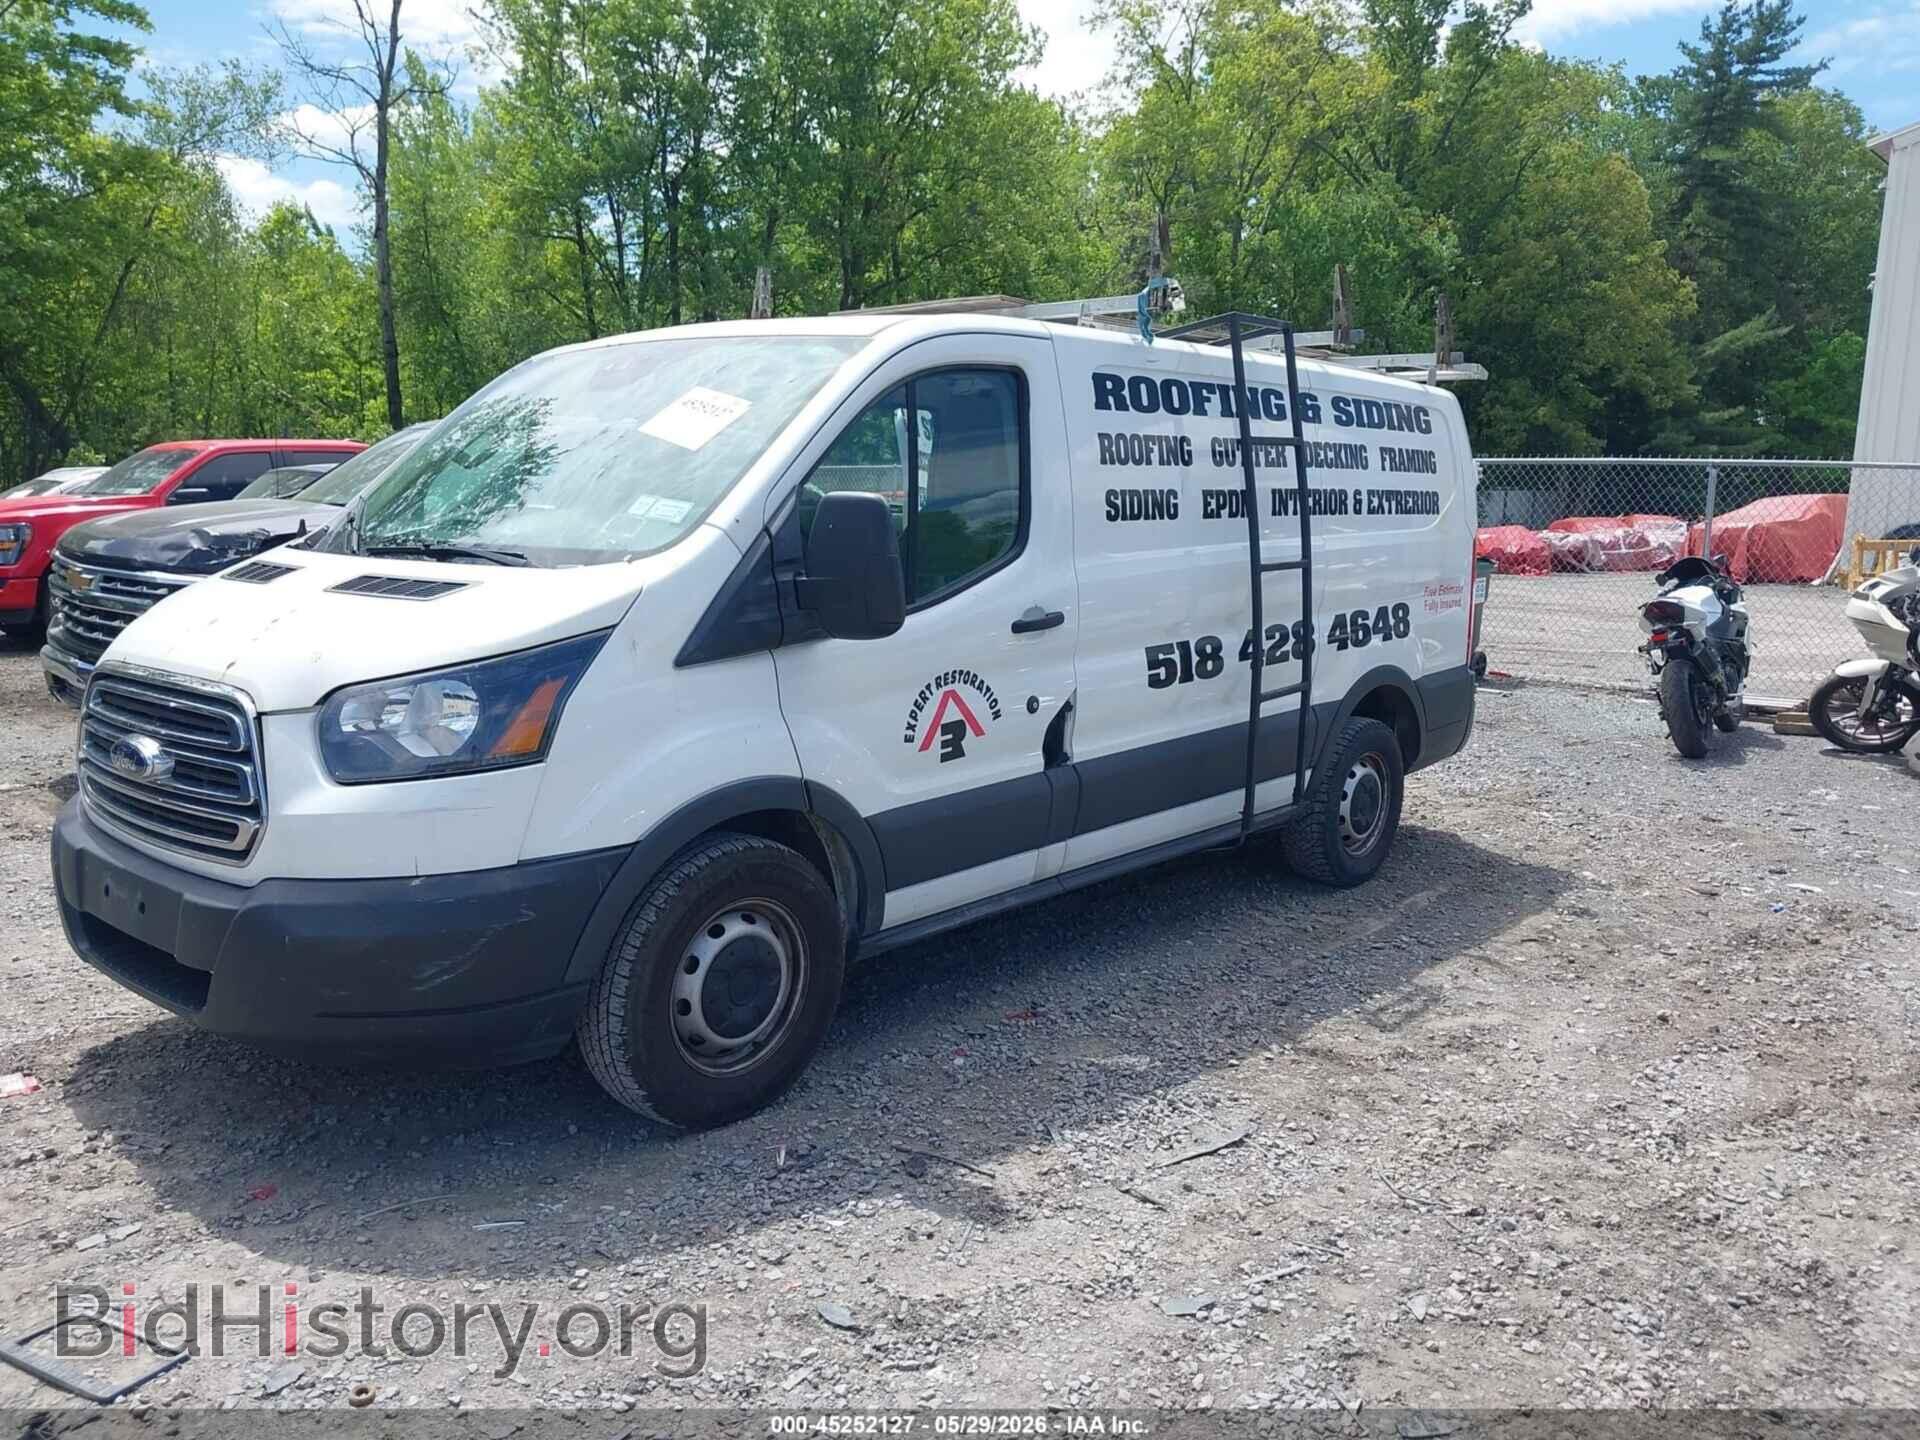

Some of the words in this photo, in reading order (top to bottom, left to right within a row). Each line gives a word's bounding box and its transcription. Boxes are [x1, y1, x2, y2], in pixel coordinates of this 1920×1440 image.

[1091, 372, 1287, 422] ROOFING
[1296, 391, 1322, 425] &
[1330, 395, 1432, 435] SIDING
[1097, 432, 1193, 467] ROOFING
[1303, 441, 1369, 471] DECKING
[1379, 446, 1438, 475] FRAMING
[1105, 489, 1179, 522] SIDING
[1352, 488, 1363, 515] &
[1366, 488, 1440, 516] EXTRERIOR
[1145, 635, 1225, 689] 518
[1238, 620, 1316, 669] 428
[1327, 602, 1410, 651] 4648
[903, 682, 934, 743] EXPERT
[934, 669, 1002, 721] RESTORATION
